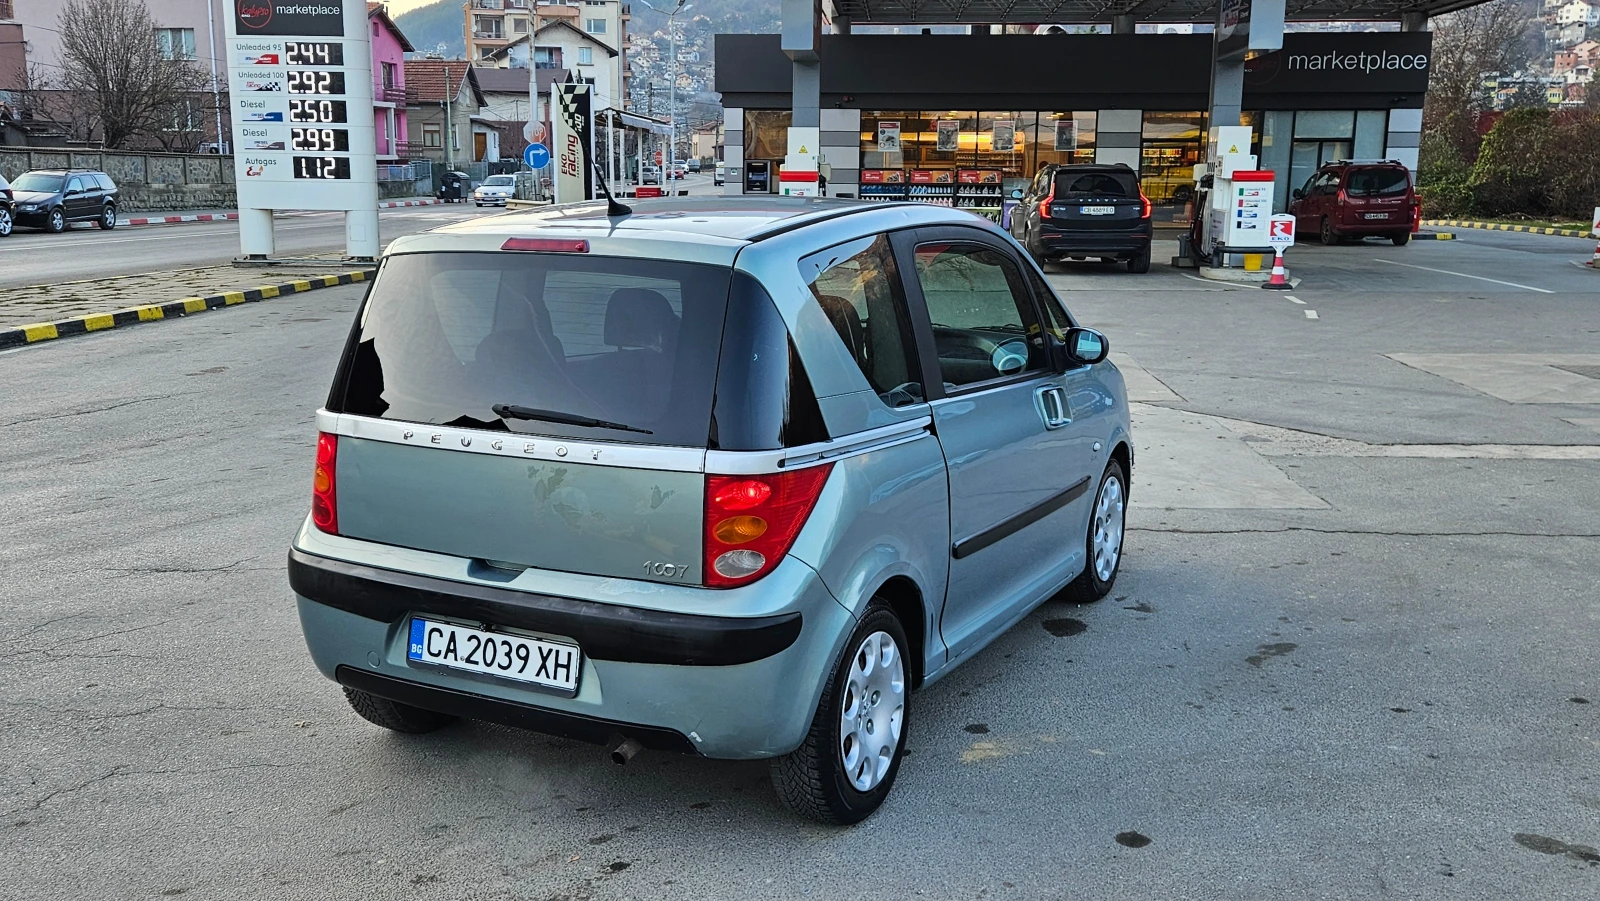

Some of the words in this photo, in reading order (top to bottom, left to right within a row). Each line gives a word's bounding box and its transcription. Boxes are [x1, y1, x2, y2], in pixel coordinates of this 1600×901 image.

[276, 4, 340, 16] marketplace
[236, 43, 270, 51] Unleaded
[286, 42, 330, 65] 2.44
[1288, 49, 1428, 74] marketplace
[238, 71, 271, 79] Unleaded
[287, 71, 331, 94] 2.92
[240, 100, 265, 108] Diesel
[290, 100, 333, 122] 2.50
[292, 128, 335, 151] 2.99
[245, 157, 277, 166] Autogas
[567, 134, 579, 178] racing
[301, 157, 336, 179] 1.12
[403, 429, 602, 460] PEUGEOT
[643, 560, 690, 579] 1007
[411, 644, 423, 654] BG
[426, 627, 458, 662] CA
[464, 634, 530, 674] 2039
[535, 646, 572, 682] XH
